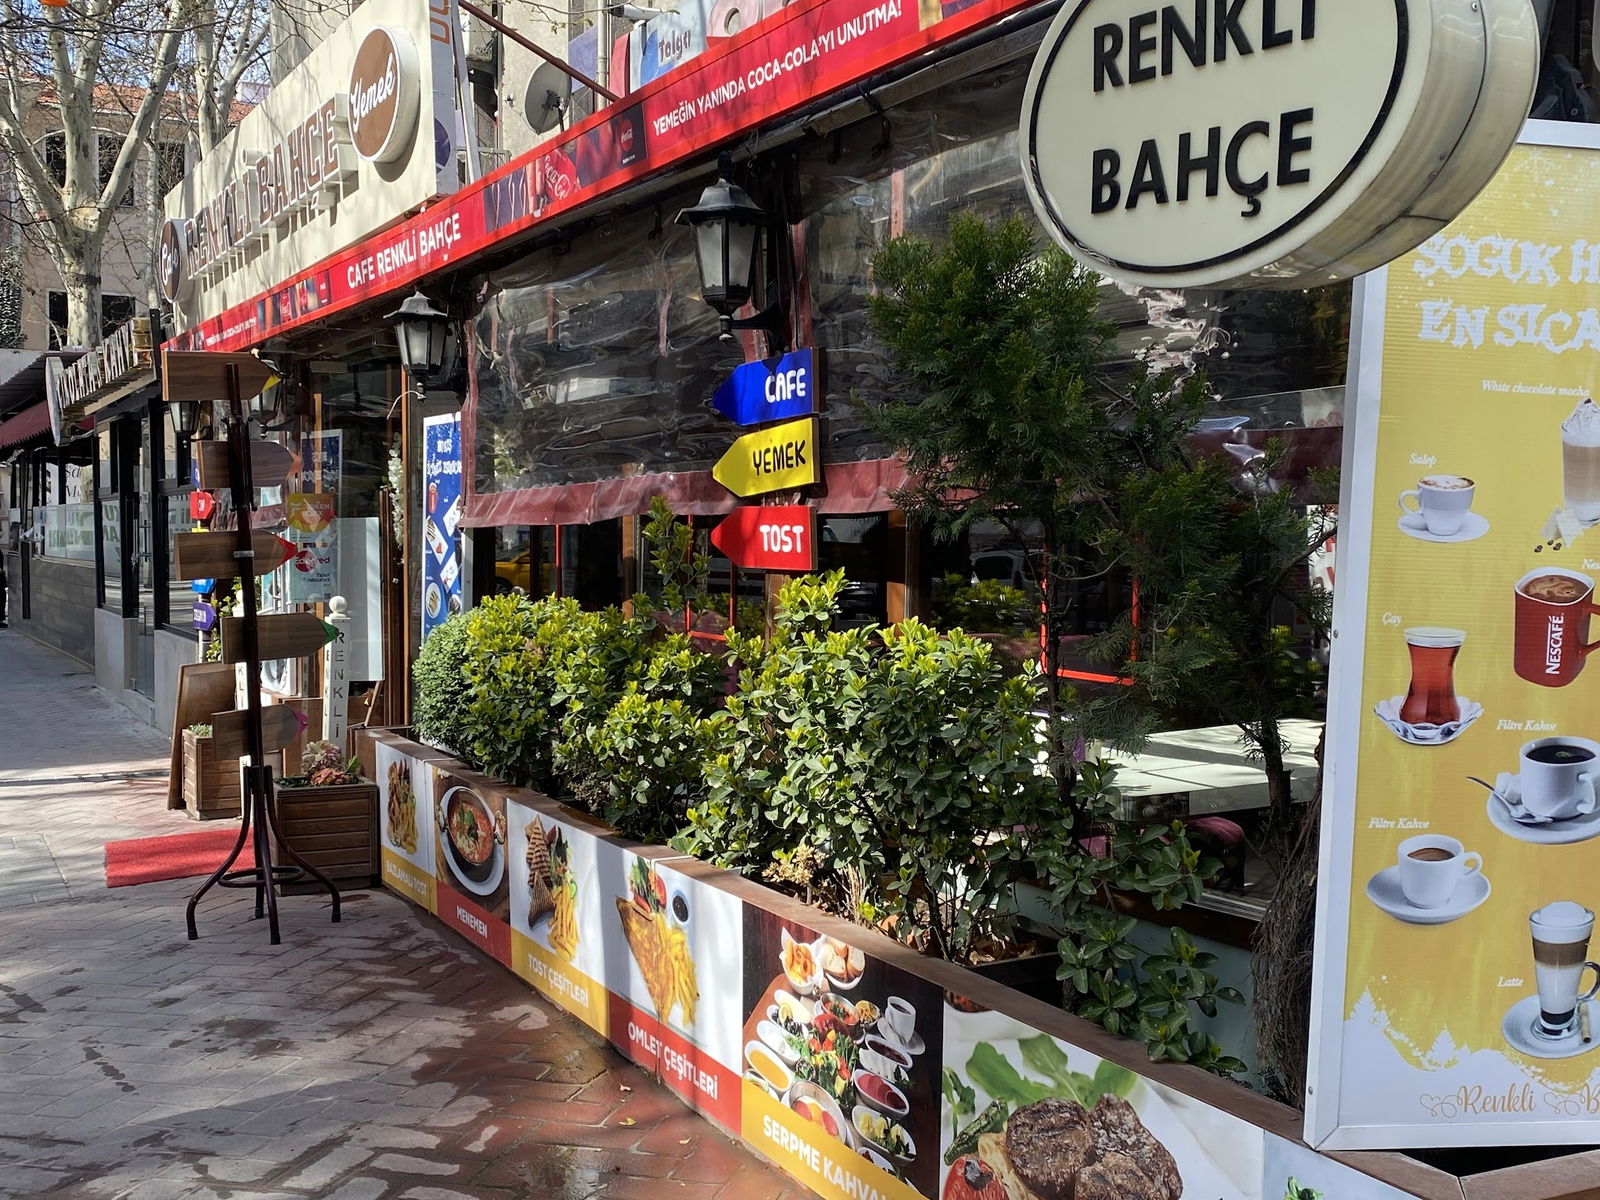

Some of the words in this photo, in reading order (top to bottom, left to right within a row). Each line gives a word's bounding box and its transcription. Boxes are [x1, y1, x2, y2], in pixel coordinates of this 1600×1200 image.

[350, 52, 396, 134] Yemek
[653, 101, 696, 138] YEMEĞİN
[697, 77, 746, 116] YANINDA
[1091, 107, 1314, 217] BAHÇE
[347, 256, 375, 289] CAFE
[376, 229, 417, 276] RENKLİ
[419, 212, 461, 250] BAHÇE
[1418, 298, 1490, 349] EN
[764, 367, 806, 403] CAFE
[1482, 380, 1510, 392] White
[752, 439, 806, 476] YEMEK
[759, 524, 804, 553] TOST
[1545, 613, 1564, 675] NESCAFÉ
[1496, 720, 1523, 731] Filtre
[1524, 720, 1556, 732] Kahve
[1368, 817, 1395, 828] Filtre
[1397, 817, 1430, 829] Kahve
[456, 905, 488, 939] MENEMEN
[527, 953, 547, 978] TOST
[548, 968, 589, 1009] ÇEŞİTLERİ
[1497, 976, 1524, 987] Latte
[627, 1023, 661, 1058] OMLET
[664, 1045, 718, 1101] ÇEŞİTLERİ
[1457, 1082, 1536, 1115] Renkli
[763, 1114, 821, 1173] SERPME
